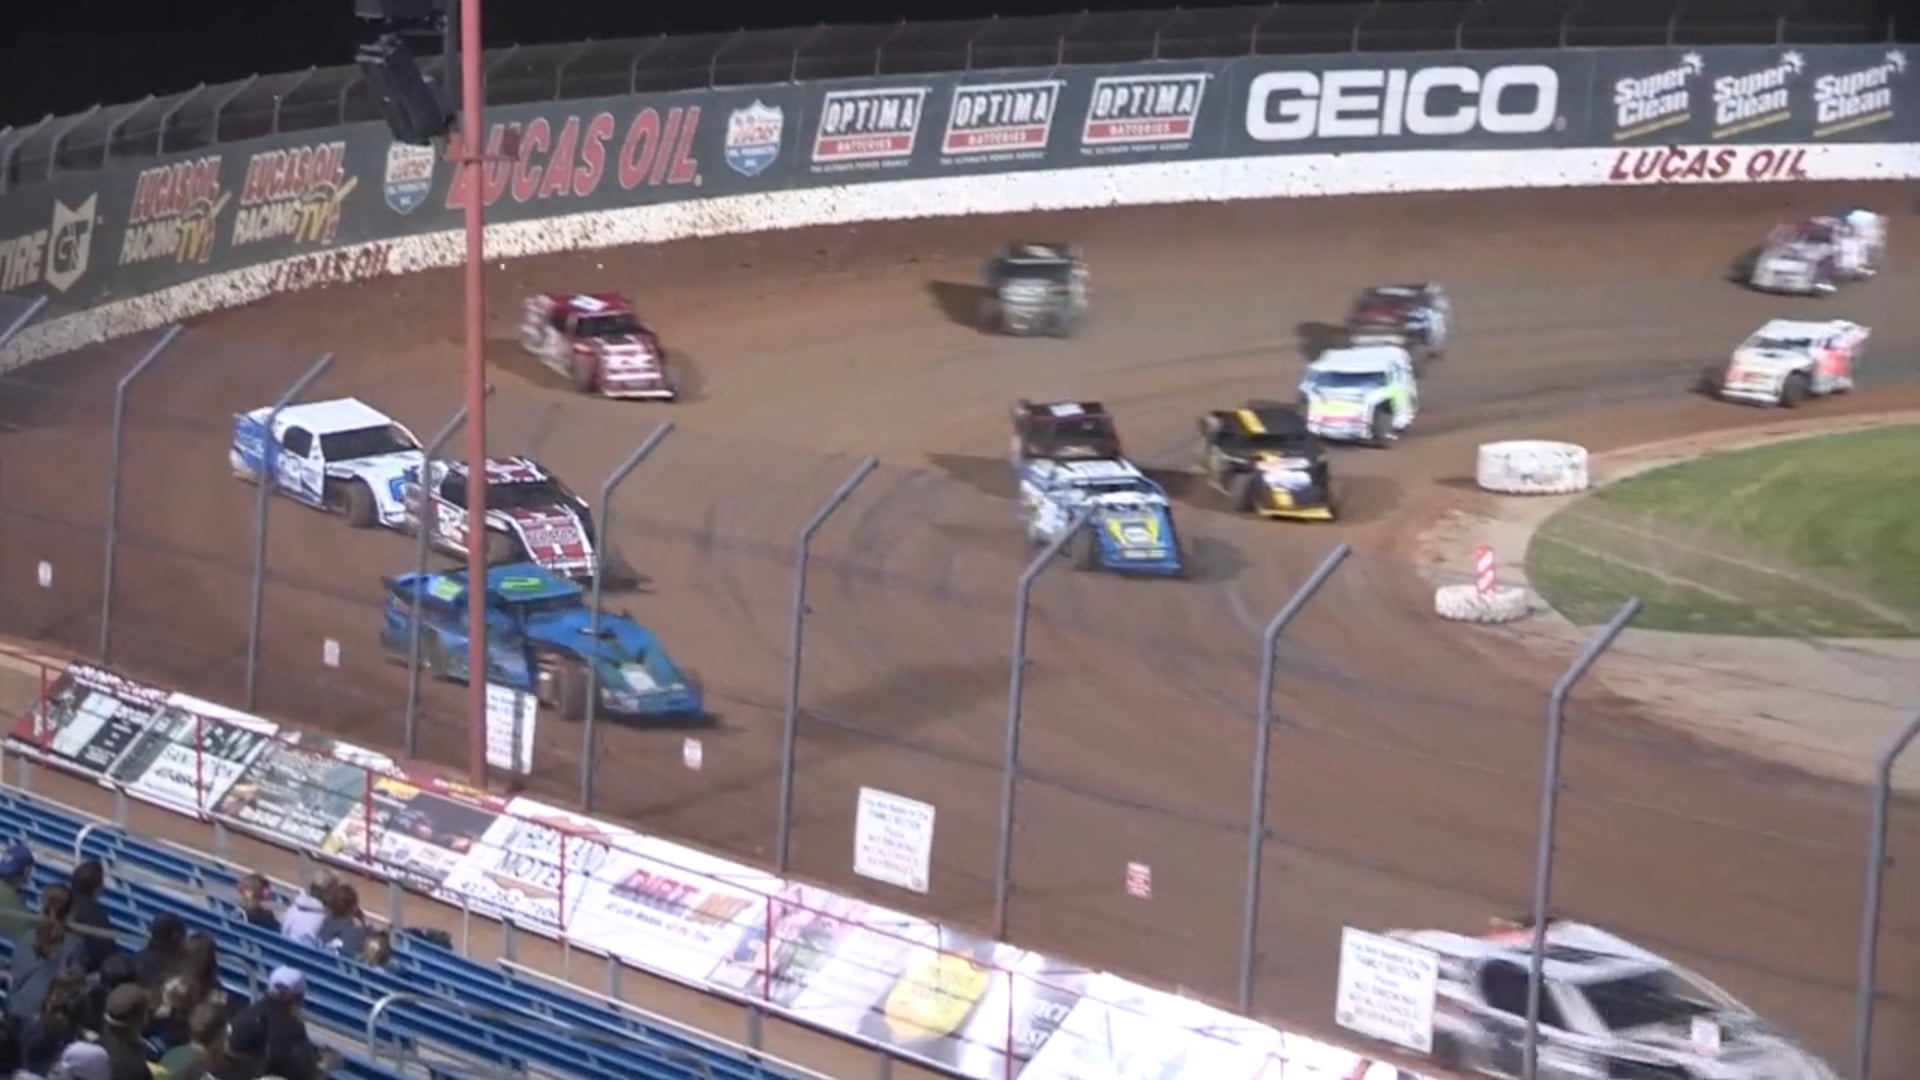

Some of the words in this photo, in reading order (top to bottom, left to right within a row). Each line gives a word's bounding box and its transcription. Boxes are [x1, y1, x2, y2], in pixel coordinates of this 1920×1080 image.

[1096, 84, 1194, 117] OPTIMA
[1614, 65, 1693, 103] Super
[1712, 64, 1792, 102] Super
[1813, 63, 1896, 101] Super
[825, 97, 913, 133] OPTIMA
[956, 91, 1048, 127] OPTIMA
[1246, 65, 1558, 141] GEICO
[1617, 90, 1690, 127] Clean
[1715, 88, 1789, 125] Clean
[1817, 87, 1892, 123] Clean
[1609, 149, 1737, 181] LUCAS
[1745, 148, 1808, 179] OIL
[232, 201, 302, 246] RACING
[295, 199, 338, 245] TV
[118, 217, 183, 266] RACING
[176, 218, 216, 264] TV
[0, 230, 48, 292] TIRE
